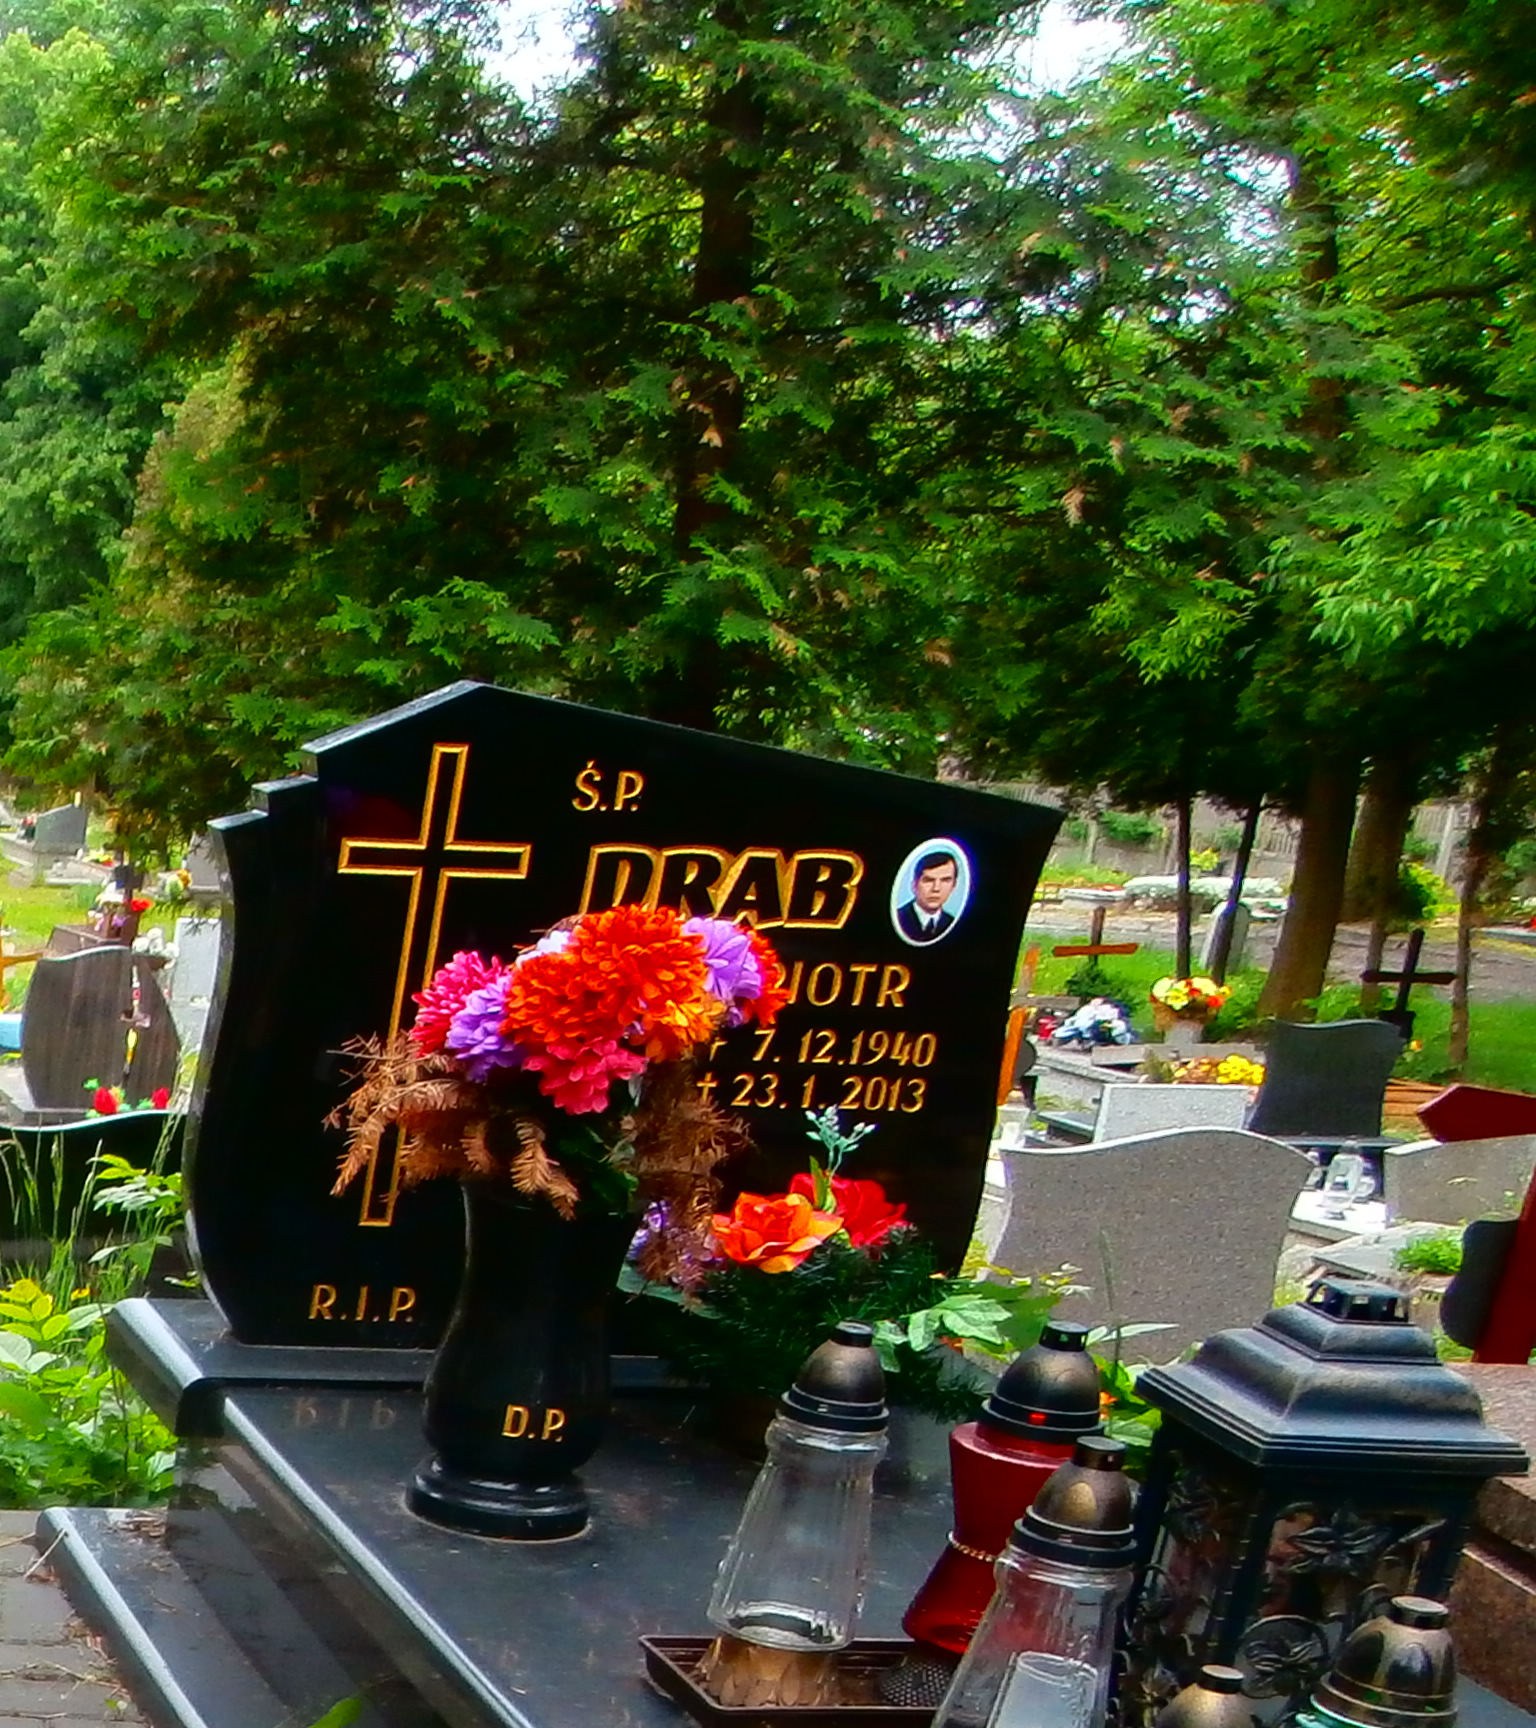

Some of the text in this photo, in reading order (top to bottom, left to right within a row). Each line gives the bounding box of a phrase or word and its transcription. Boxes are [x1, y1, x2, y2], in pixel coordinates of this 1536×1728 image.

[572, 759, 645, 812] Ś.P.
[578, 843, 865, 930] DRAB
[308, 1283, 417, 1323] R.I.P.
[500, 1403, 566, 1443] D.P.
